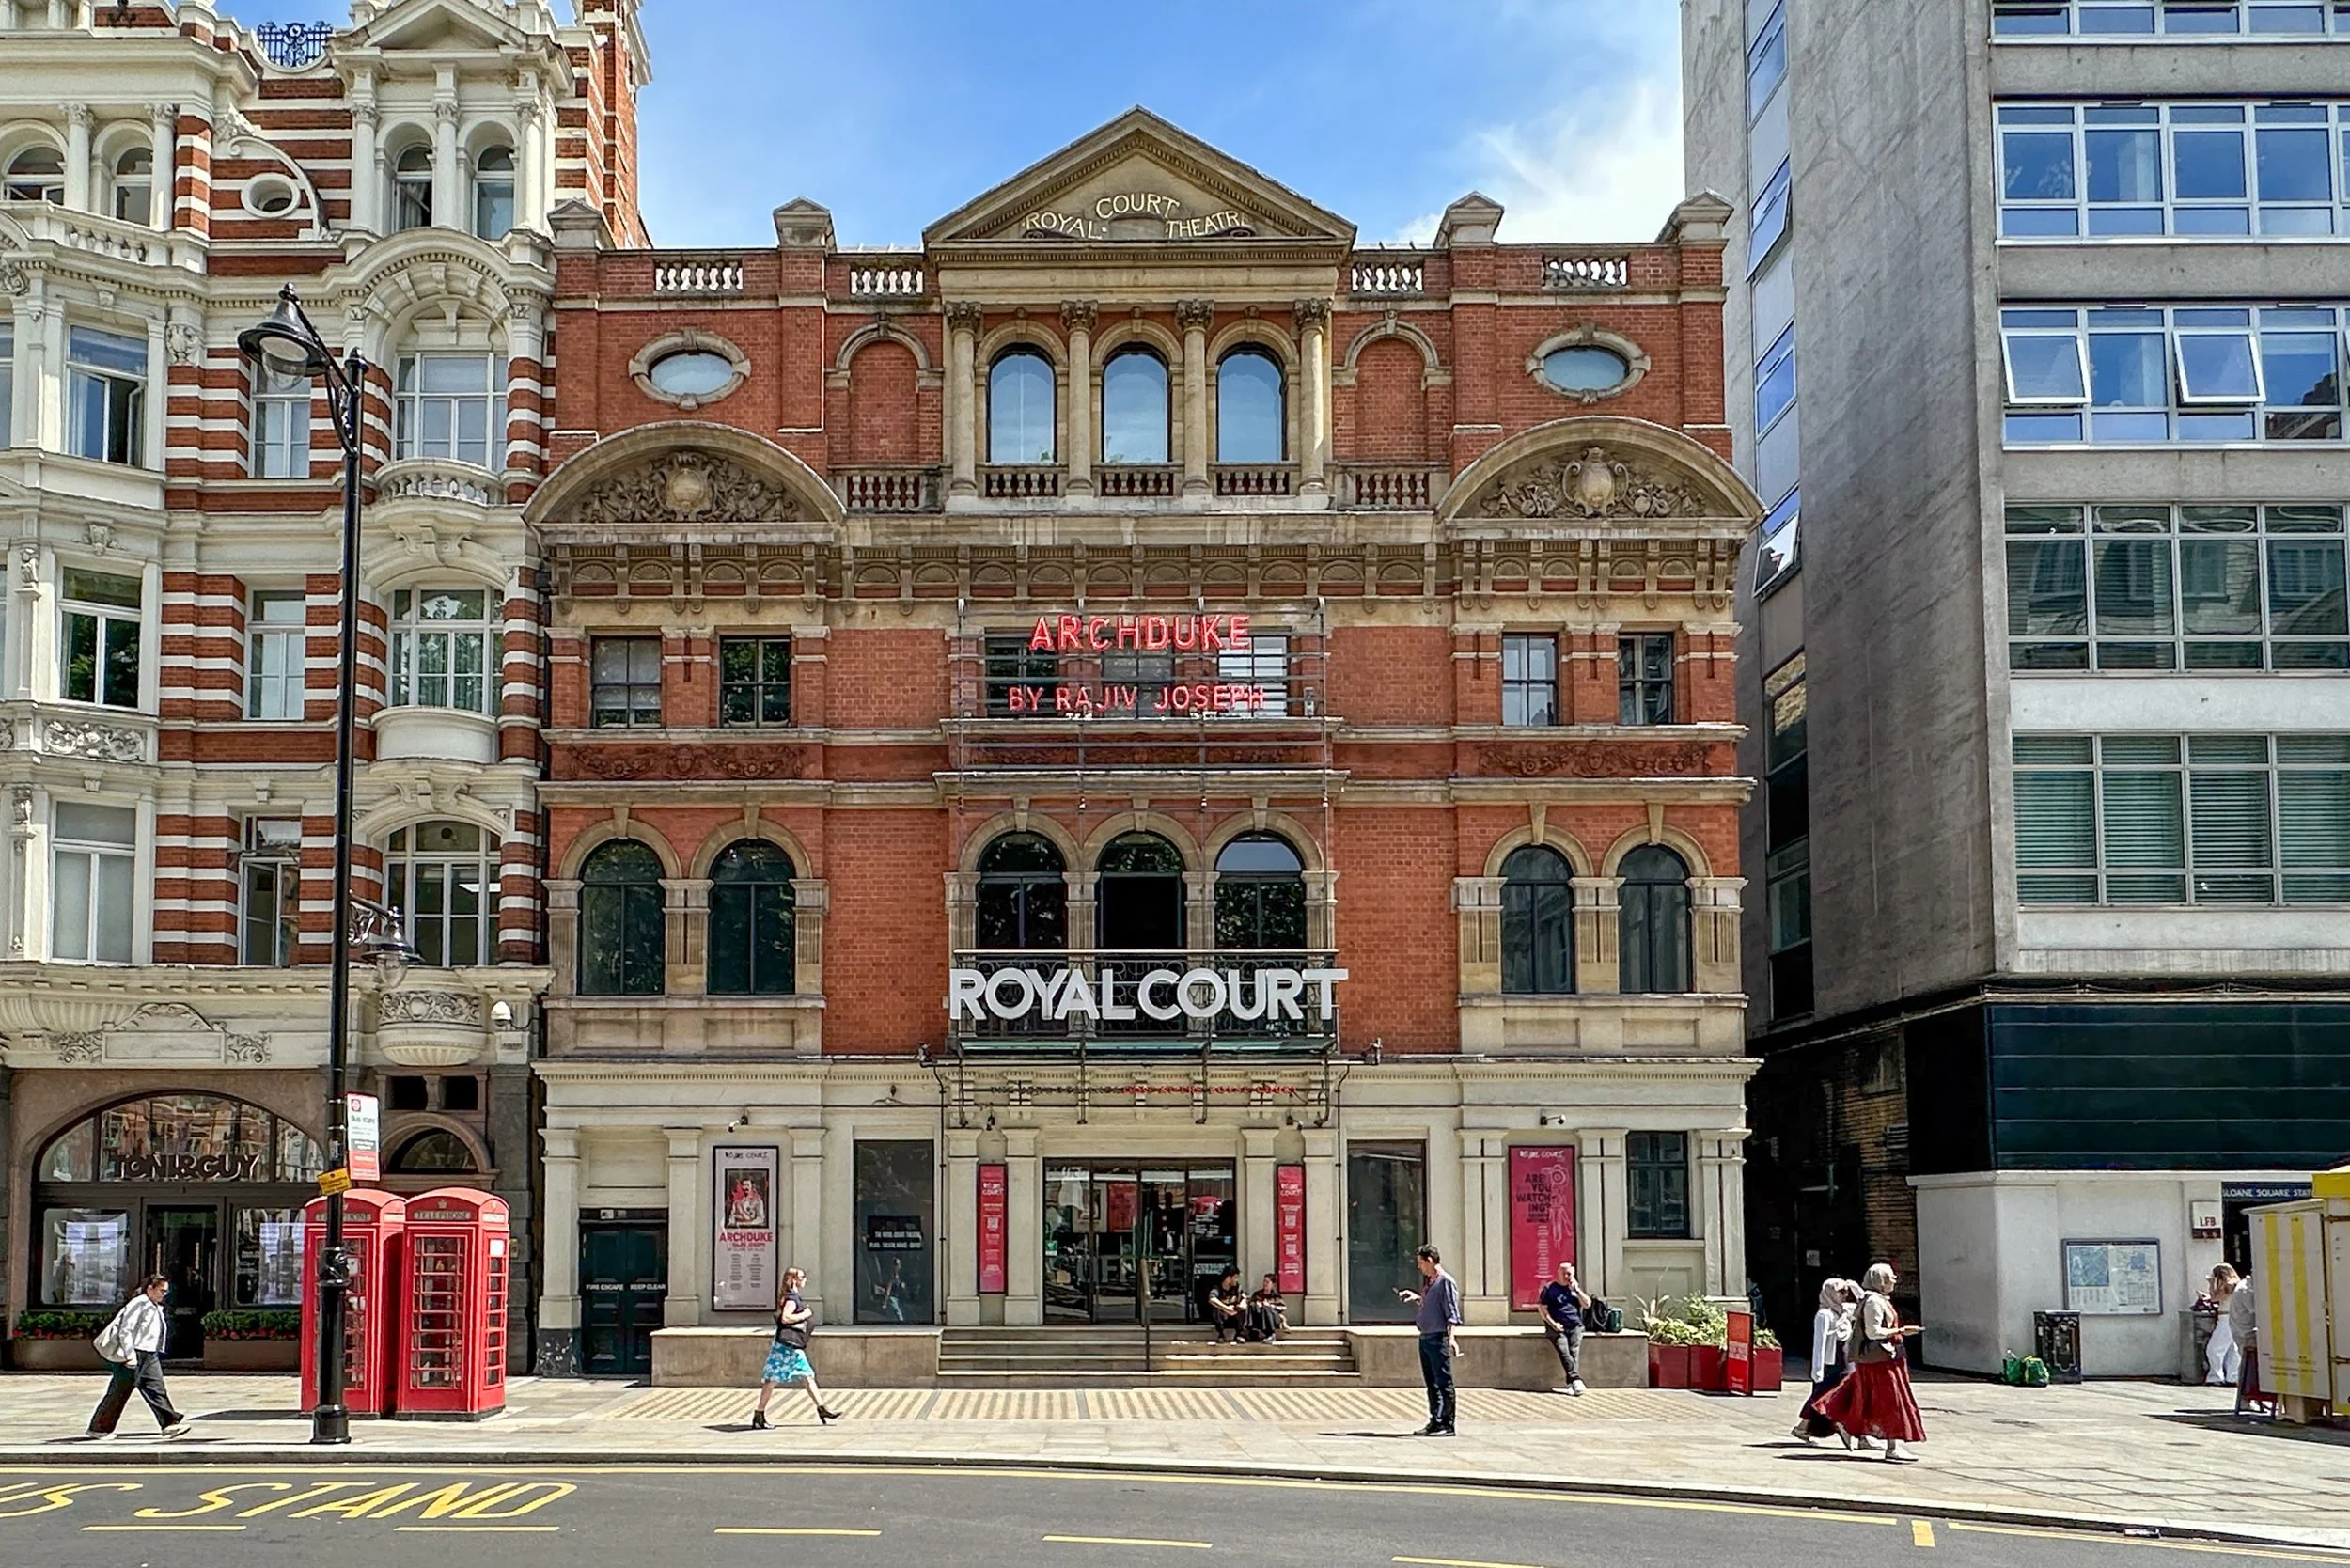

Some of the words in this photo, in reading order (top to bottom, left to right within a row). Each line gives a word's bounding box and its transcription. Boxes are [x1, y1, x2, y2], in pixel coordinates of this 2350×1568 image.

[1025, 212, 1102, 239] ROYAL
[1095, 192, 1180, 219] COURT
[1029, 615, 1250, 651] ARCHDUKE
[1008, 686, 1044, 712] BY
[1055, 685, 1138, 712] RAJIV
[1154, 684, 1266, 712] JOSEPH
[1525, 1173, 1544, 1183] ARE
[1530, 1183, 1552, 1192] YOU
[2256, 1188, 2291, 1198] SQUARE
[417, 1211, 469, 1220] TELEPHONE
[2200, 1216, 2217, 1227] LFB
[719, 1231, 773, 1242] ARCHDUKE
[133, 1482, 578, 1520] STAND
